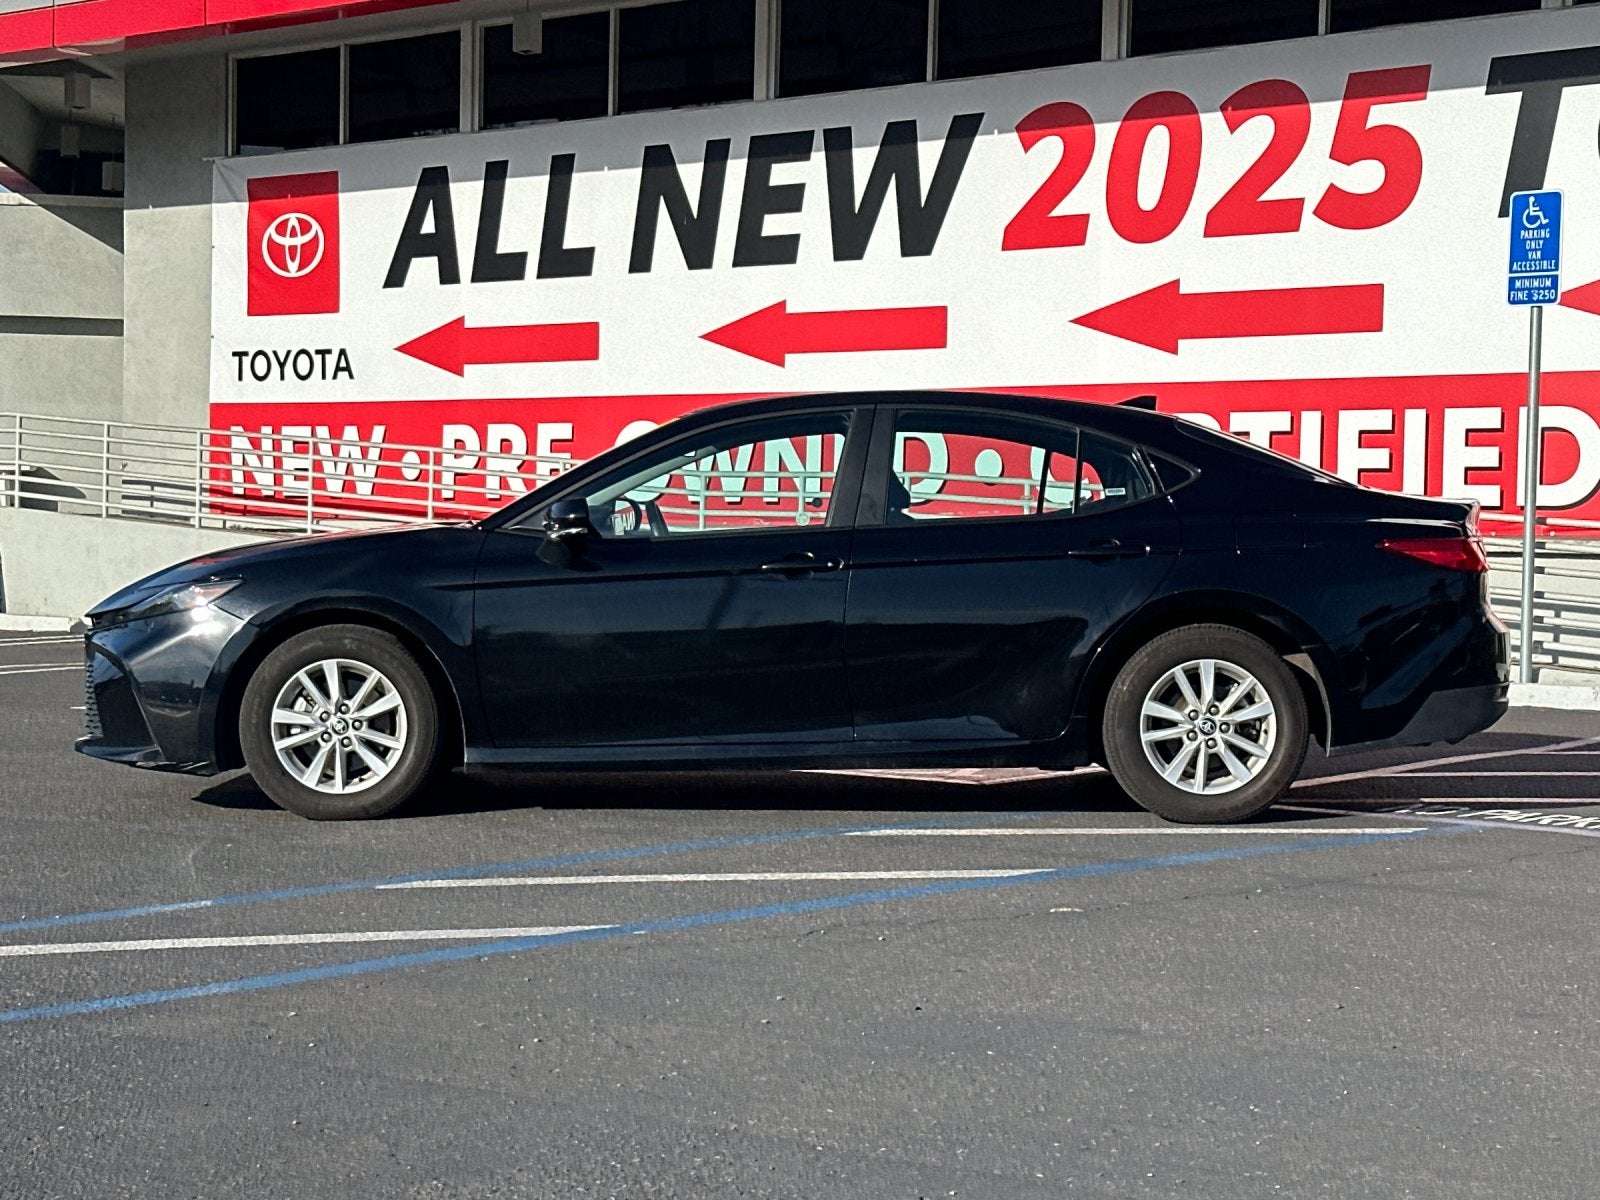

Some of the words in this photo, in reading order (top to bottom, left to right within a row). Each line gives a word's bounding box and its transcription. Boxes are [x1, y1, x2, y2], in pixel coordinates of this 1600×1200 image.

[383, 153, 596, 288] ALL
[628, 112, 985, 274] NEW
[1002, 64, 1432, 251] 2025
[1484, 45, 1600, 218] T
[1520, 228, 1550, 240] PARKING
[1525, 240, 1544, 250] ONLY
[1528, 250, 1541, 260] VAN
[1512, 259, 1556, 271] ACCESSIBLE
[1515, 278, 1552, 289] MINIMUM
[1510, 290, 1529, 301] FINE
[1531, 289, 1556, 301] $250
[231, 348, 355, 382] TOYOTA
[230, 424, 386, 498] NEW
[614, 419, 948, 503] WND
[1030, 405, 1600, 508] CTIFIED
[1457, 809, 1600, 829] PARK
